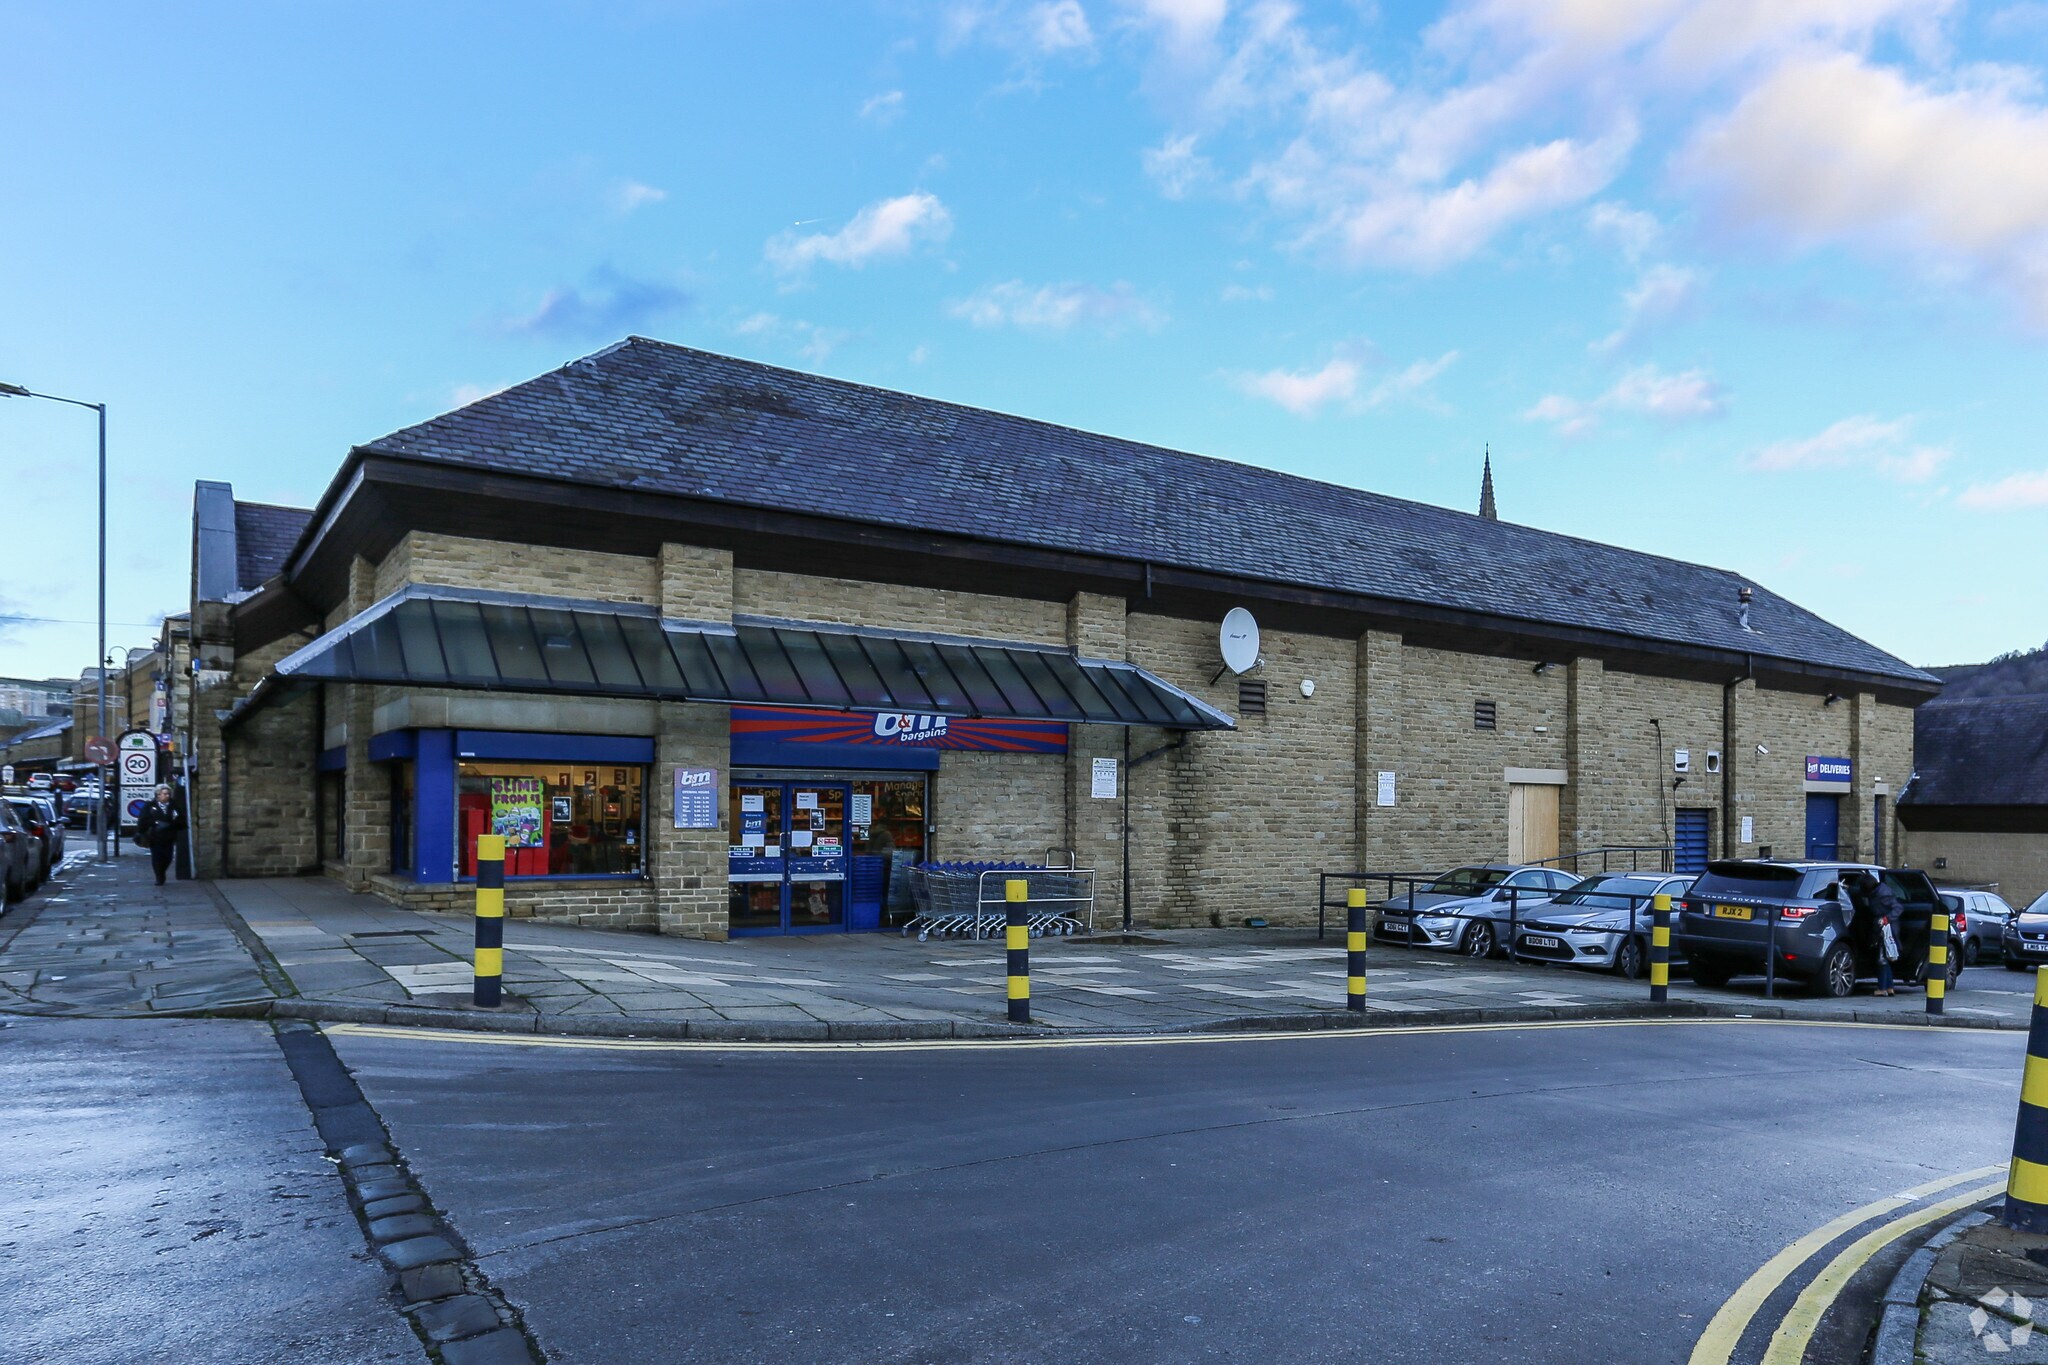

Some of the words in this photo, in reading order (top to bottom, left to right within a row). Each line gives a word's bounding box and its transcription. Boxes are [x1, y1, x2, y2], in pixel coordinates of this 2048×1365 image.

[901, 728, 947, 741] bargains
[129, 759, 147, 769] 20
[1820, 764, 1850, 775] DELIVERIES
[561, 775, 567, 786] 1
[586, 773, 595, 785] 2
[615, 771, 625, 781] 3
[493, 779, 540, 793] SLIME
[493, 794, 528, 804] FROM
[1722, 907, 1737, 916] RJX
[1737, 908, 1743, 917] 2
[1543, 939, 1556, 947] LTU
